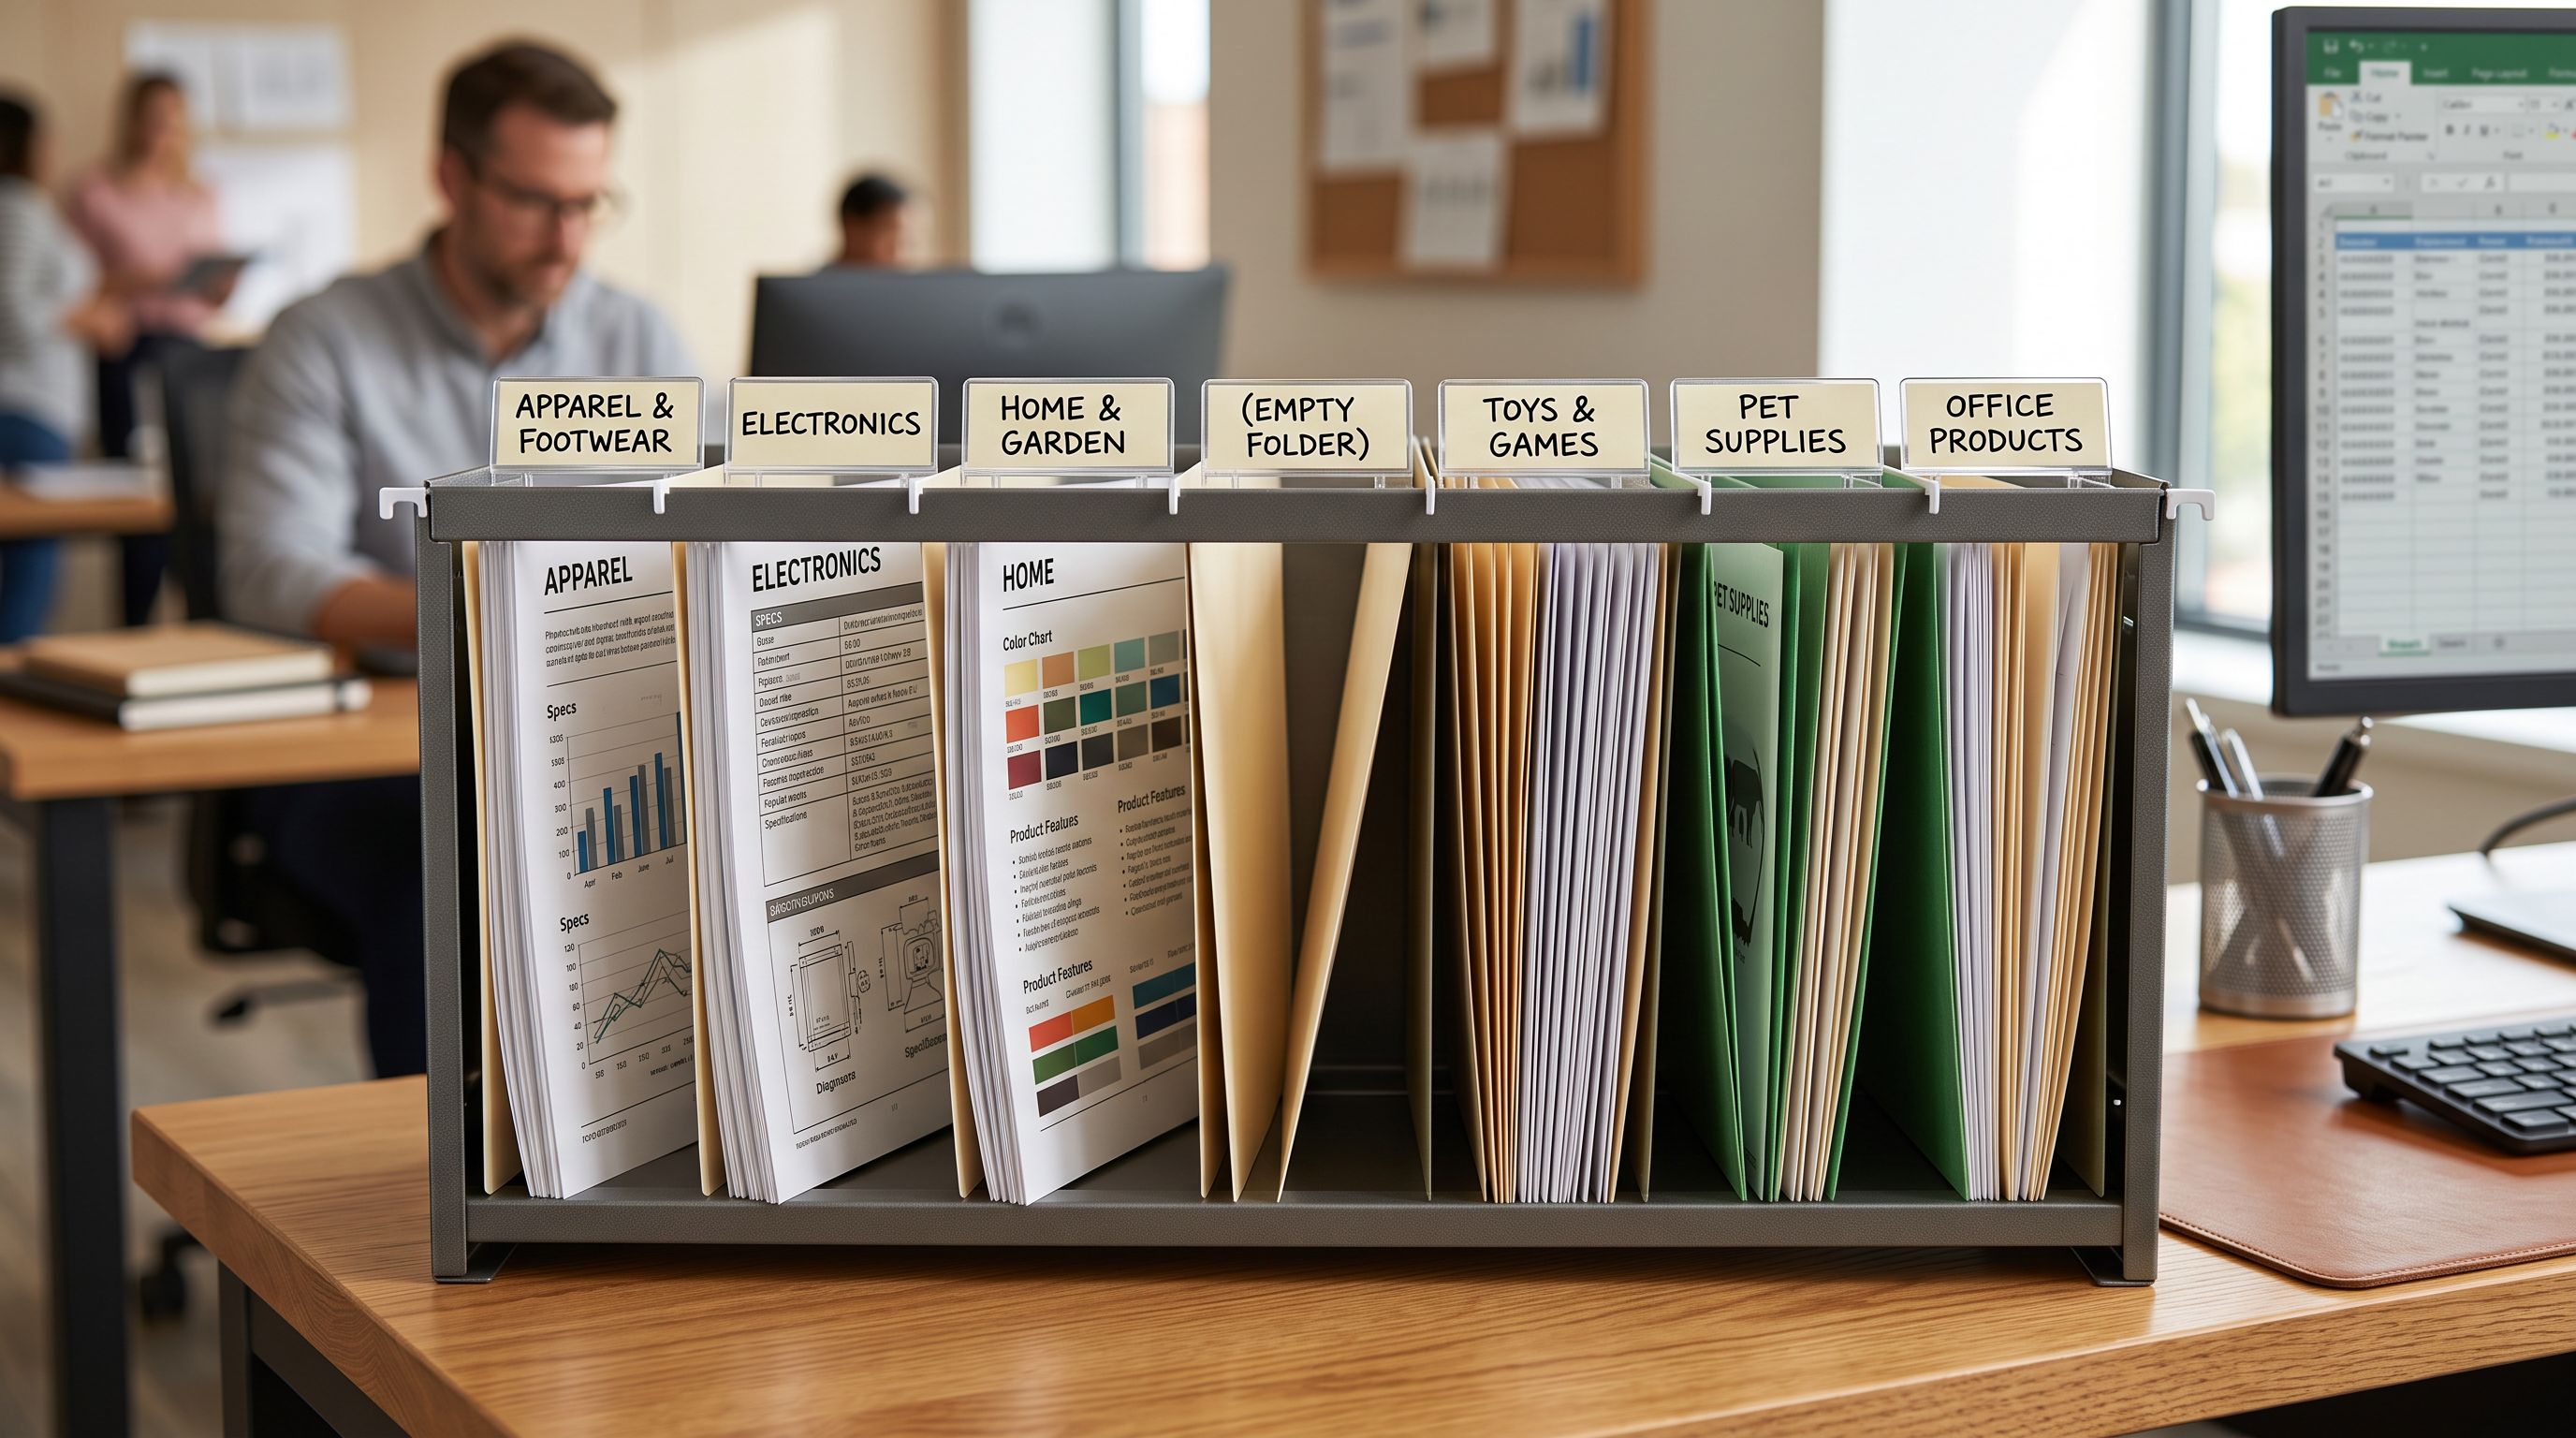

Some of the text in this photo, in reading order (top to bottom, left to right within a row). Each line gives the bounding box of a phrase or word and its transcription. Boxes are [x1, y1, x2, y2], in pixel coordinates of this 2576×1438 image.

[516, 392, 674, 418] APPAREL &
[1002, 393, 1121, 420] HOME &
[1242, 392, 1354, 428] (EMPTY
[1482, 394, 1596, 423] TOYS &
[1739, 393, 1799, 419] PET
[1946, 393, 2055, 418] OFFICE
[741, 411, 921, 436] ELECTRONICS
[520, 428, 672, 453] FOOTWEAR
[1002, 430, 1125, 455] GARDEN
[1247, 427, 1369, 462] FOLDER)
[1489, 431, 1600, 458] GAMES
[1705, 429, 1847, 455] SUPPLIES
[1929, 428, 2084, 453] PRODUCTS
[544, 555, 633, 595] APPAREL
[753, 546, 881, 593] ELECTRONICS
[1003, 557, 1055, 592] HOME
[755, 610, 783, 627] SPECS
[1729, 587, 1769, 628] SUPPLIES
[1003, 634, 1027, 652] Color
[547, 702, 577, 722] Specs
[1118, 785, 1186, 814] Product Features
[556, 827, 568, 837] 200
[1010, 822, 1044, 844] Product
[559, 849, 570, 859] 100
[560, 912, 590, 934] Specs
[564, 943, 576, 953] 120
[1023, 970, 1057, 994] Product
[576, 1041, 584, 1050] 20
